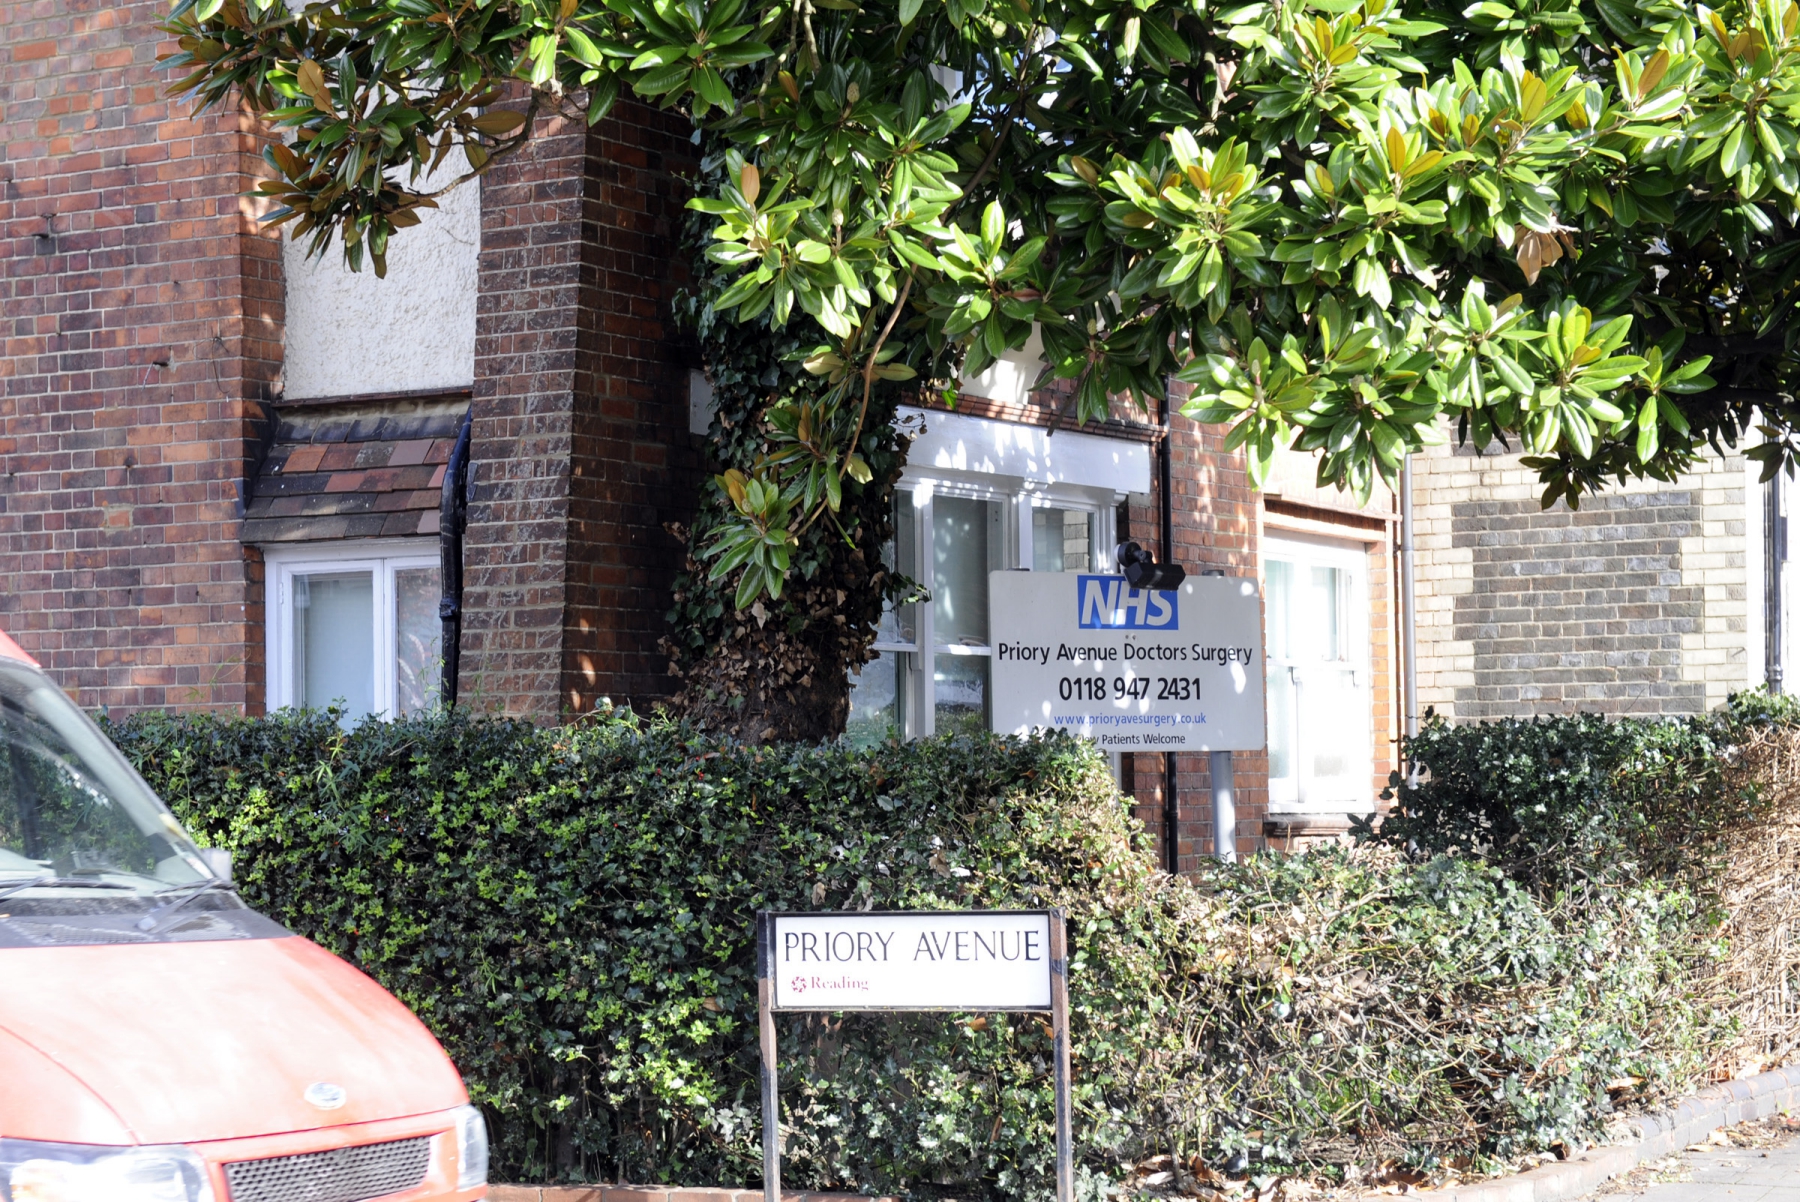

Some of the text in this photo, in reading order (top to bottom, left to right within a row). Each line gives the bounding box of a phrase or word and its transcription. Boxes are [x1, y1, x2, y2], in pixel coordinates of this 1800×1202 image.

[1081, 579, 1173, 626] NHS
[998, 641, 1253, 666] Priory Avenue Doctors Surgery
[1059, 676, 1201, 701] 0118 947 2431
[1054, 712, 1207, 727] www.prioryavesurgery.co.uk
[1102, 733, 1141, 745] Patients
[1143, 733, 1186, 745] Welcome
[784, 930, 1041, 962] PRIORY AVENUE
[811, 976, 869, 991] Reading
